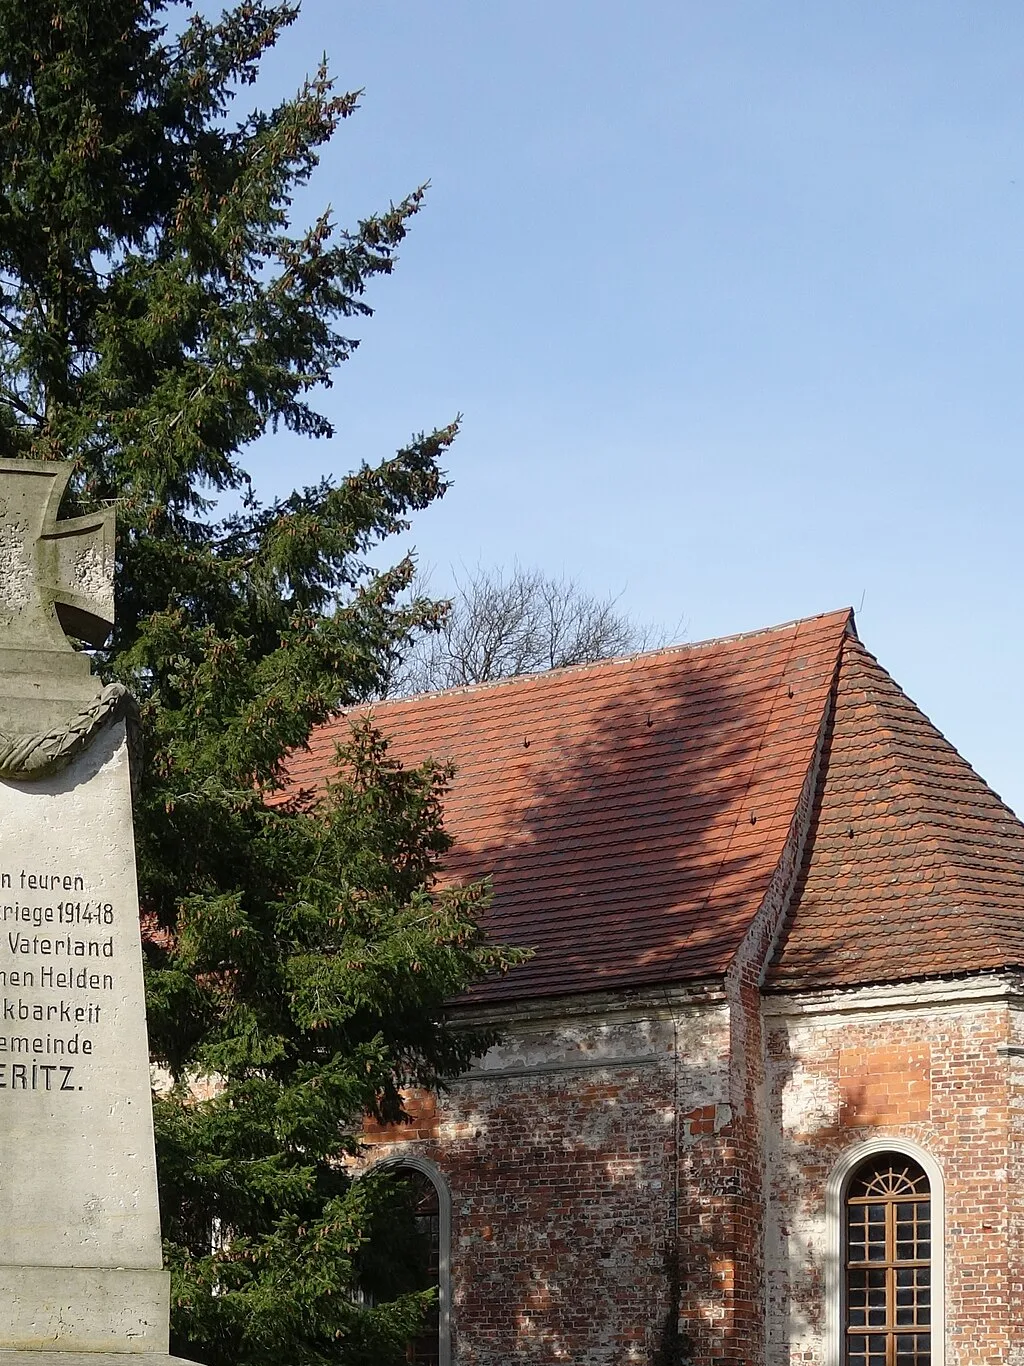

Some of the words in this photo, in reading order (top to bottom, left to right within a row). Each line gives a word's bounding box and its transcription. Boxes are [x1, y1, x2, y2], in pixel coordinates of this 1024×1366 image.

[20, 870, 84, 891] teuren
[57, 902, 113, 924] 1914-18
[9, 932, 113, 957] Vaterland
[41, 966, 113, 990] Helden
